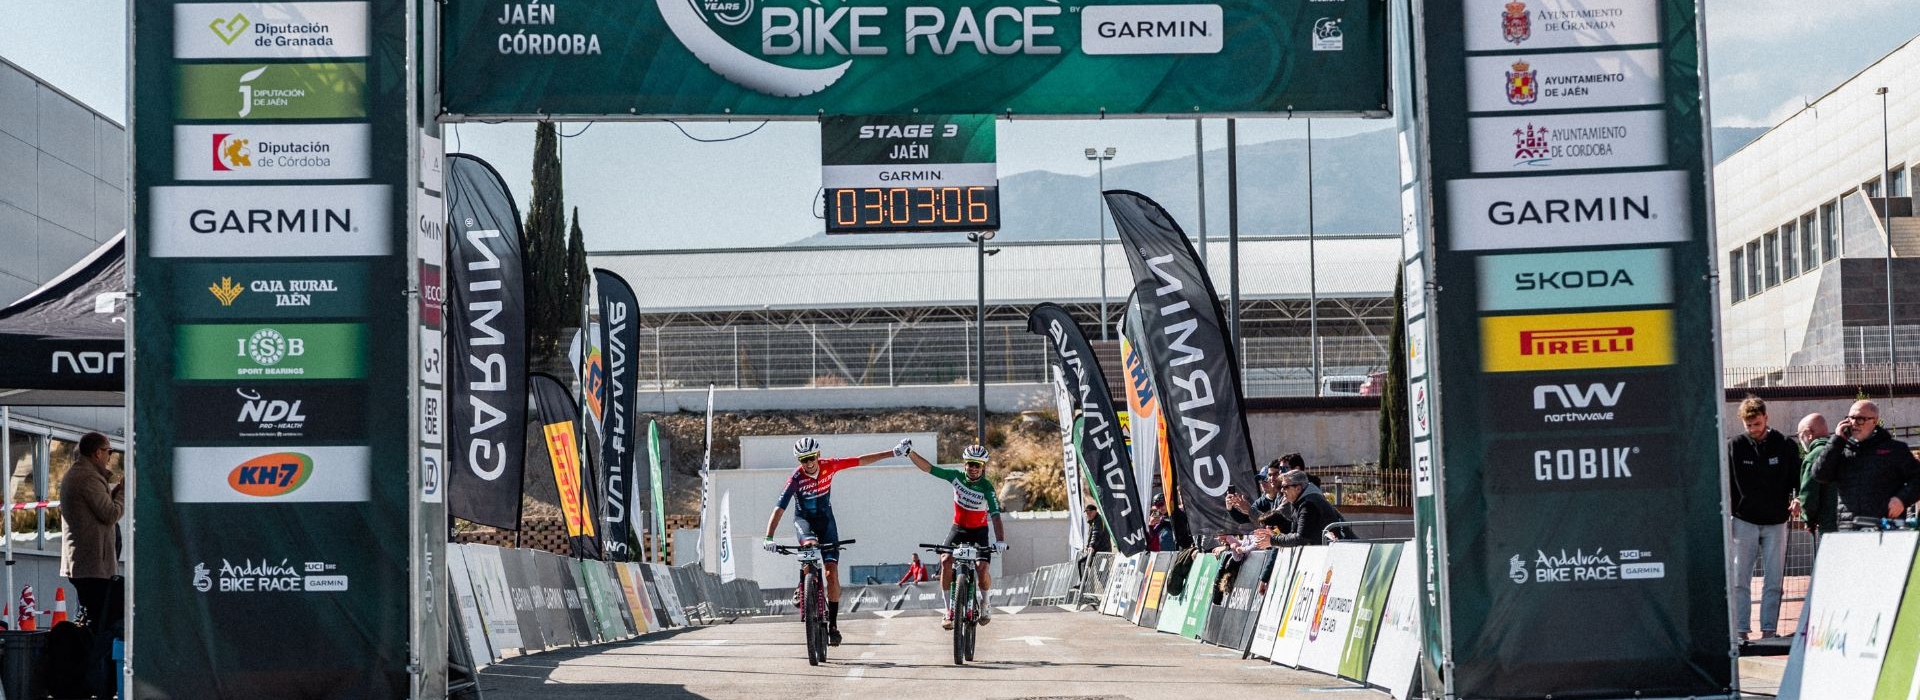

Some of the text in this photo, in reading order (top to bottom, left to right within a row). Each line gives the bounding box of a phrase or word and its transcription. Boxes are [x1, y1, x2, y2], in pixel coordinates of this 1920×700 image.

[498, 0, 555, 24] JAÉN
[705, 3, 740, 11] YEARS
[1538, 8, 1623, 20] AYUNTAMIENTO
[255, 22, 329, 35] Diputación
[762, 5, 1061, 55] BIKE RACE
[1545, 20, 1616, 31] DE GRANADA
[255, 35, 334, 47] de Granada
[498, 29, 601, 55] CÓRDOBA
[1545, 73, 1624, 84] AYUNTAMIENTO
[254, 89, 305, 97] DIPUTACIÓN
[1545, 84, 1589, 97] DE JAÉN
[254, 97, 288, 106] DE JAÉN
[859, 124, 958, 139] STAGE 3
[1552, 126, 1627, 141] AYUNTAMIENTO
[258, 141, 330, 156] Diputación
[889, 141, 929, 159] JAÉN
[1552, 143, 1613, 158] DE CORDOBA
[258, 155, 331, 167] de Córdoba
[879, 170, 942, 181] GARMIN
[836, 186, 988, 225] 03:03:06
[1488, 195, 1650, 225] GARMIN
[189, 208, 351, 233] GARMIN
[250, 280, 338, 292] CAJA RURAL
[1520, 326, 1635, 356] PIRELLI
[265, 367, 304, 375] BEARINGS
[237, 400, 306, 422] NDL
[1544, 411, 1614, 423] northwave
[1534, 447, 1632, 481] GOBIK
[803, 551, 816, 559] 3-2
[958, 548, 971, 557] 3-1
[1535, 547, 1616, 568] Andalucía
[219, 558, 300, 577] Andalucía
[1536, 565, 1660, 582] BIKE RACE GARMIN
[220, 578, 255, 591] BIKE
[258, 578, 301, 591] RACE
